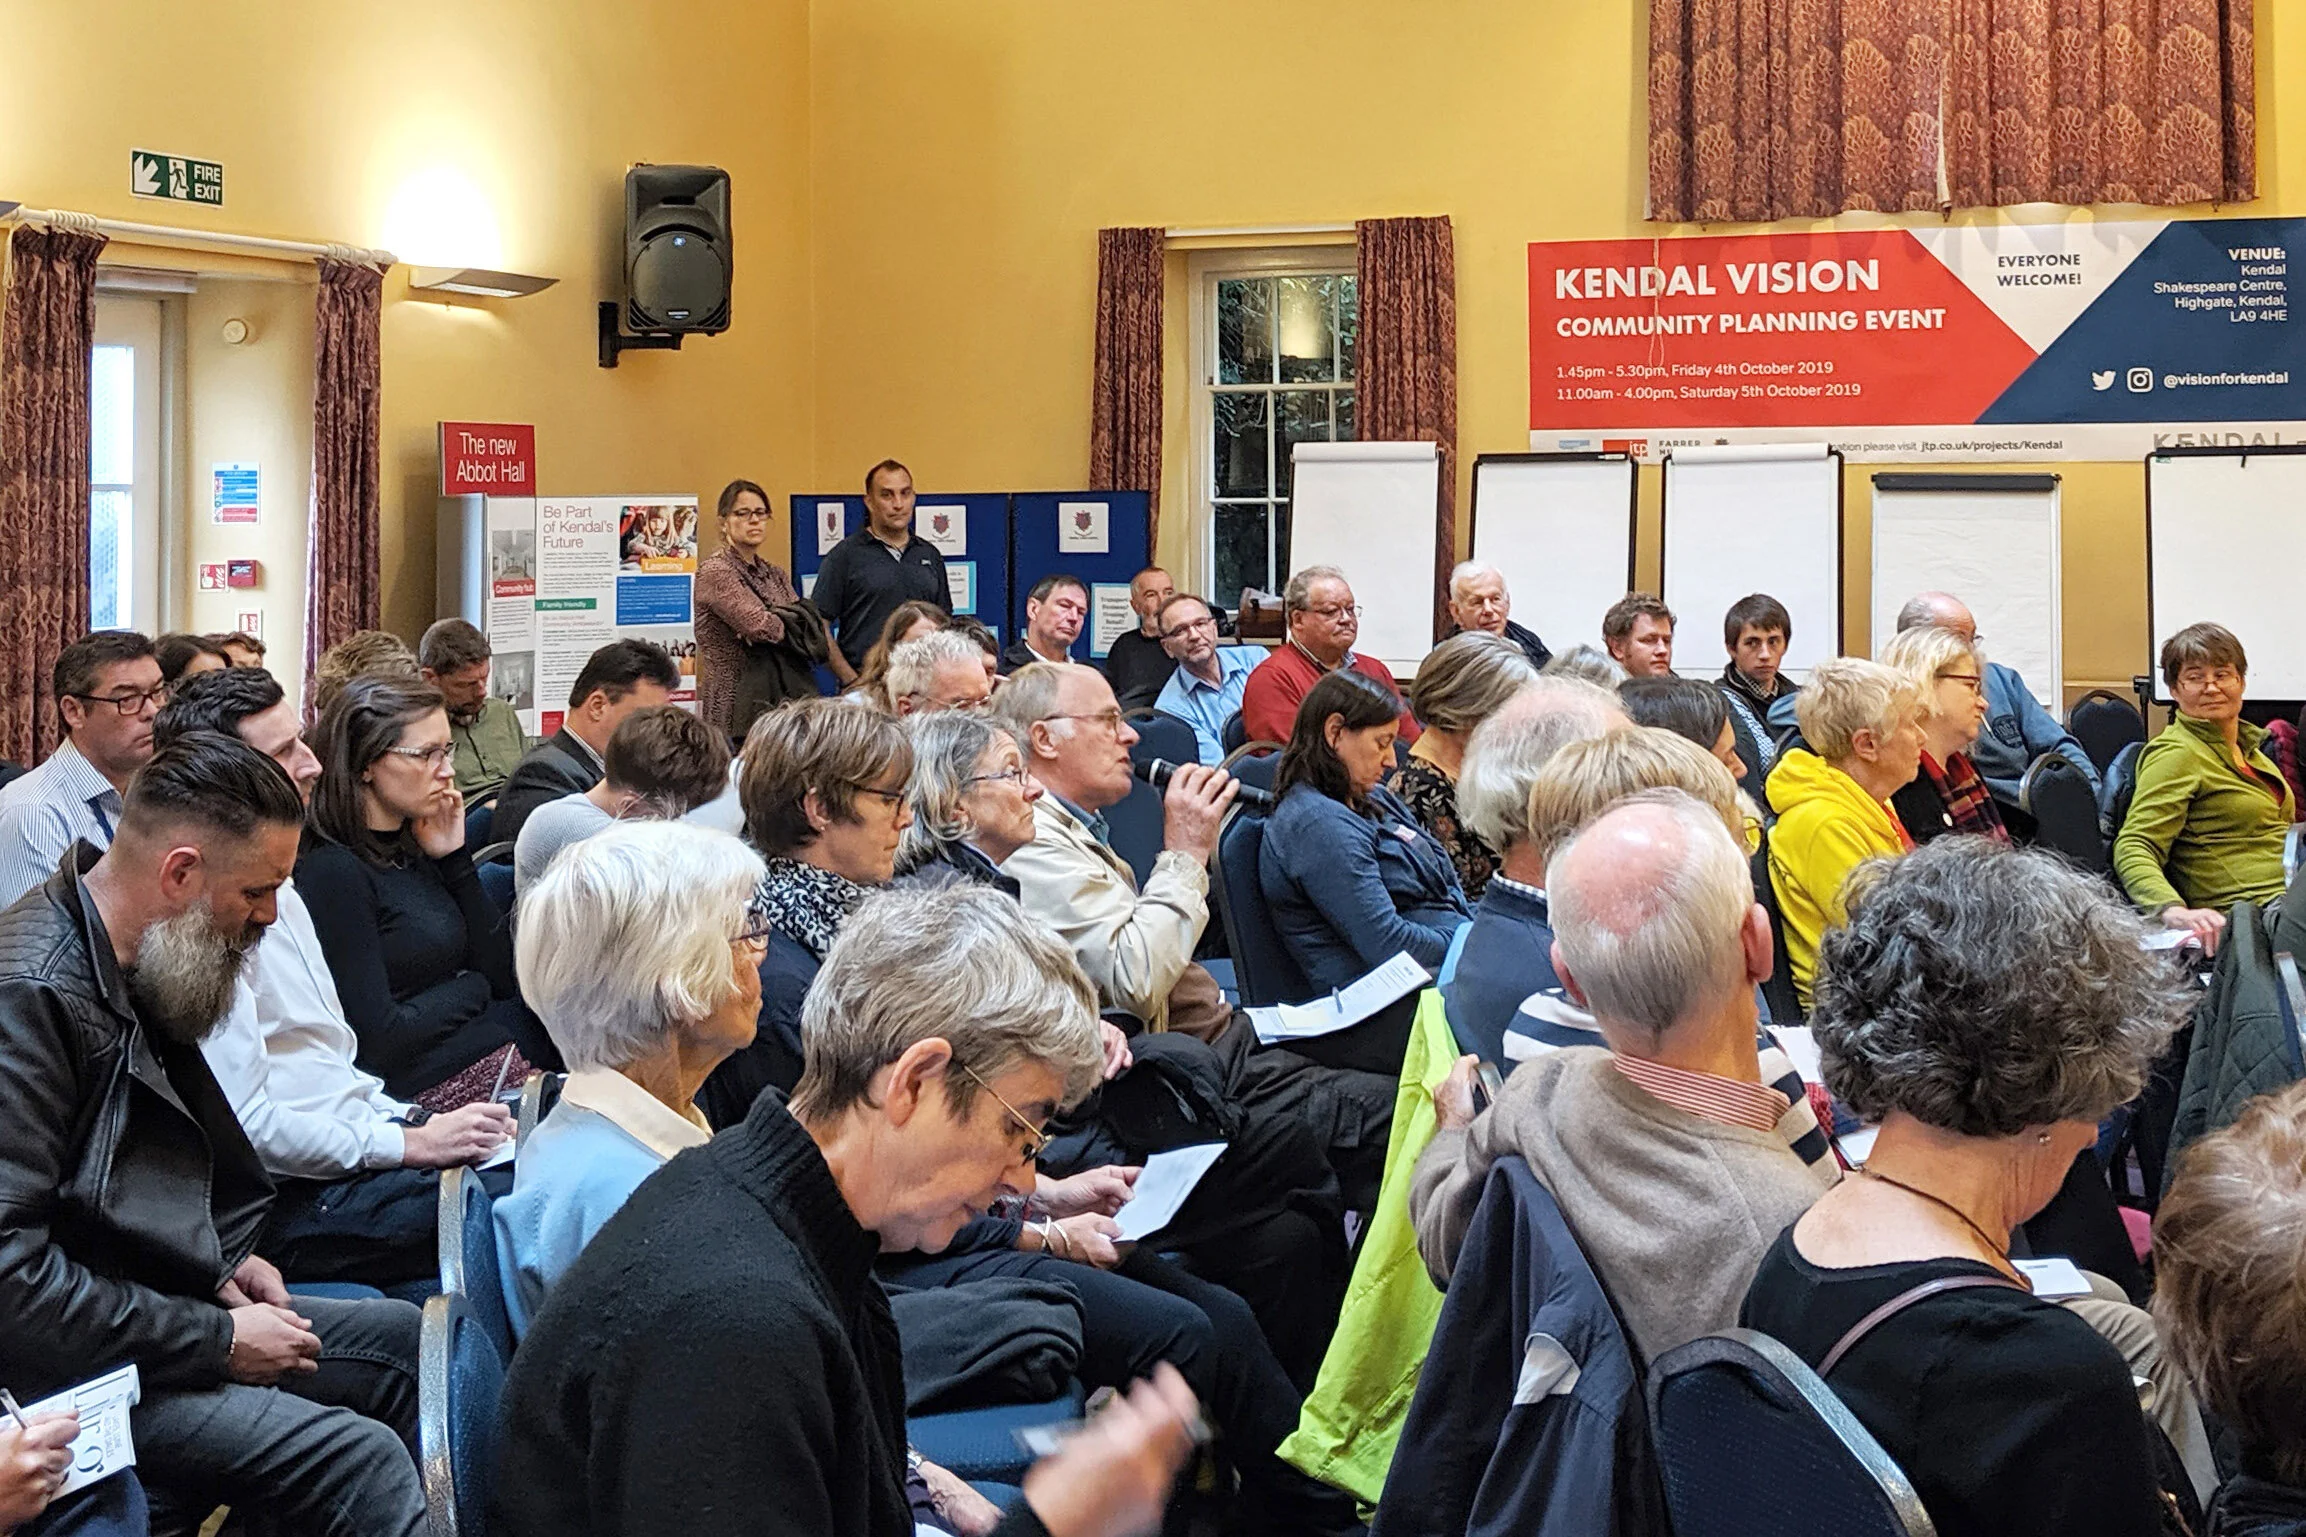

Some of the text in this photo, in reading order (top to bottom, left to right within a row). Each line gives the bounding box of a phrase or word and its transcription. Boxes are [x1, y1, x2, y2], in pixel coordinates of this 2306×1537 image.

[193, 164, 221, 182] FIRE
[194, 183, 221, 201] EXIT
[1997, 254, 2081, 267] EVERYONE
[2228, 247, 2286, 260] VENUE:
[2241, 263, 2286, 276] Kendal
[1555, 259, 1879, 299] KENDAL VISION
[1996, 273, 2082, 286] WELCOME!
[2153, 281, 2237, 295] Shakespeare
[2175, 297, 2237, 311] Highgate,
[1556, 308, 1946, 337] COMMUNITY PLANNING EVENT
[2230, 309, 2287, 322] LA9 4HE
[1557, 365, 1605, 380] 1.45pm
[1616, 364, 1670, 380] 5.30pm,
[1671, 363, 1712, 378] Friday
[1714, 363, 1737, 376] 4th
[1739, 361, 1795, 376] October
[1797, 361, 1834, 374] 2019
[2163, 371, 2289, 389] @visionforkendal
[1557, 388, 1614, 400] 11.00am
[1624, 386, 1677, 402] 4.00pm,
[1680, 385, 1738, 400] Saturday
[1741, 384, 1764, 397] 5th
[1766, 384, 1822, 397] October
[1825, 382, 1861, 396] 2019
[459, 431, 517, 455] The new
[1658, 439, 1701, 447] FARRER
[1863, 442, 1896, 452] please
[1897, 441, 1917, 451] visit
[1920, 440, 2063, 453] jtp.co.uk/projects/Kendal
[456, 460, 525, 482] Abbot Hall
[543, 504, 592, 519] Be Part
[543, 519, 614, 534] of Kendal's
[543, 535, 584, 549] Future
